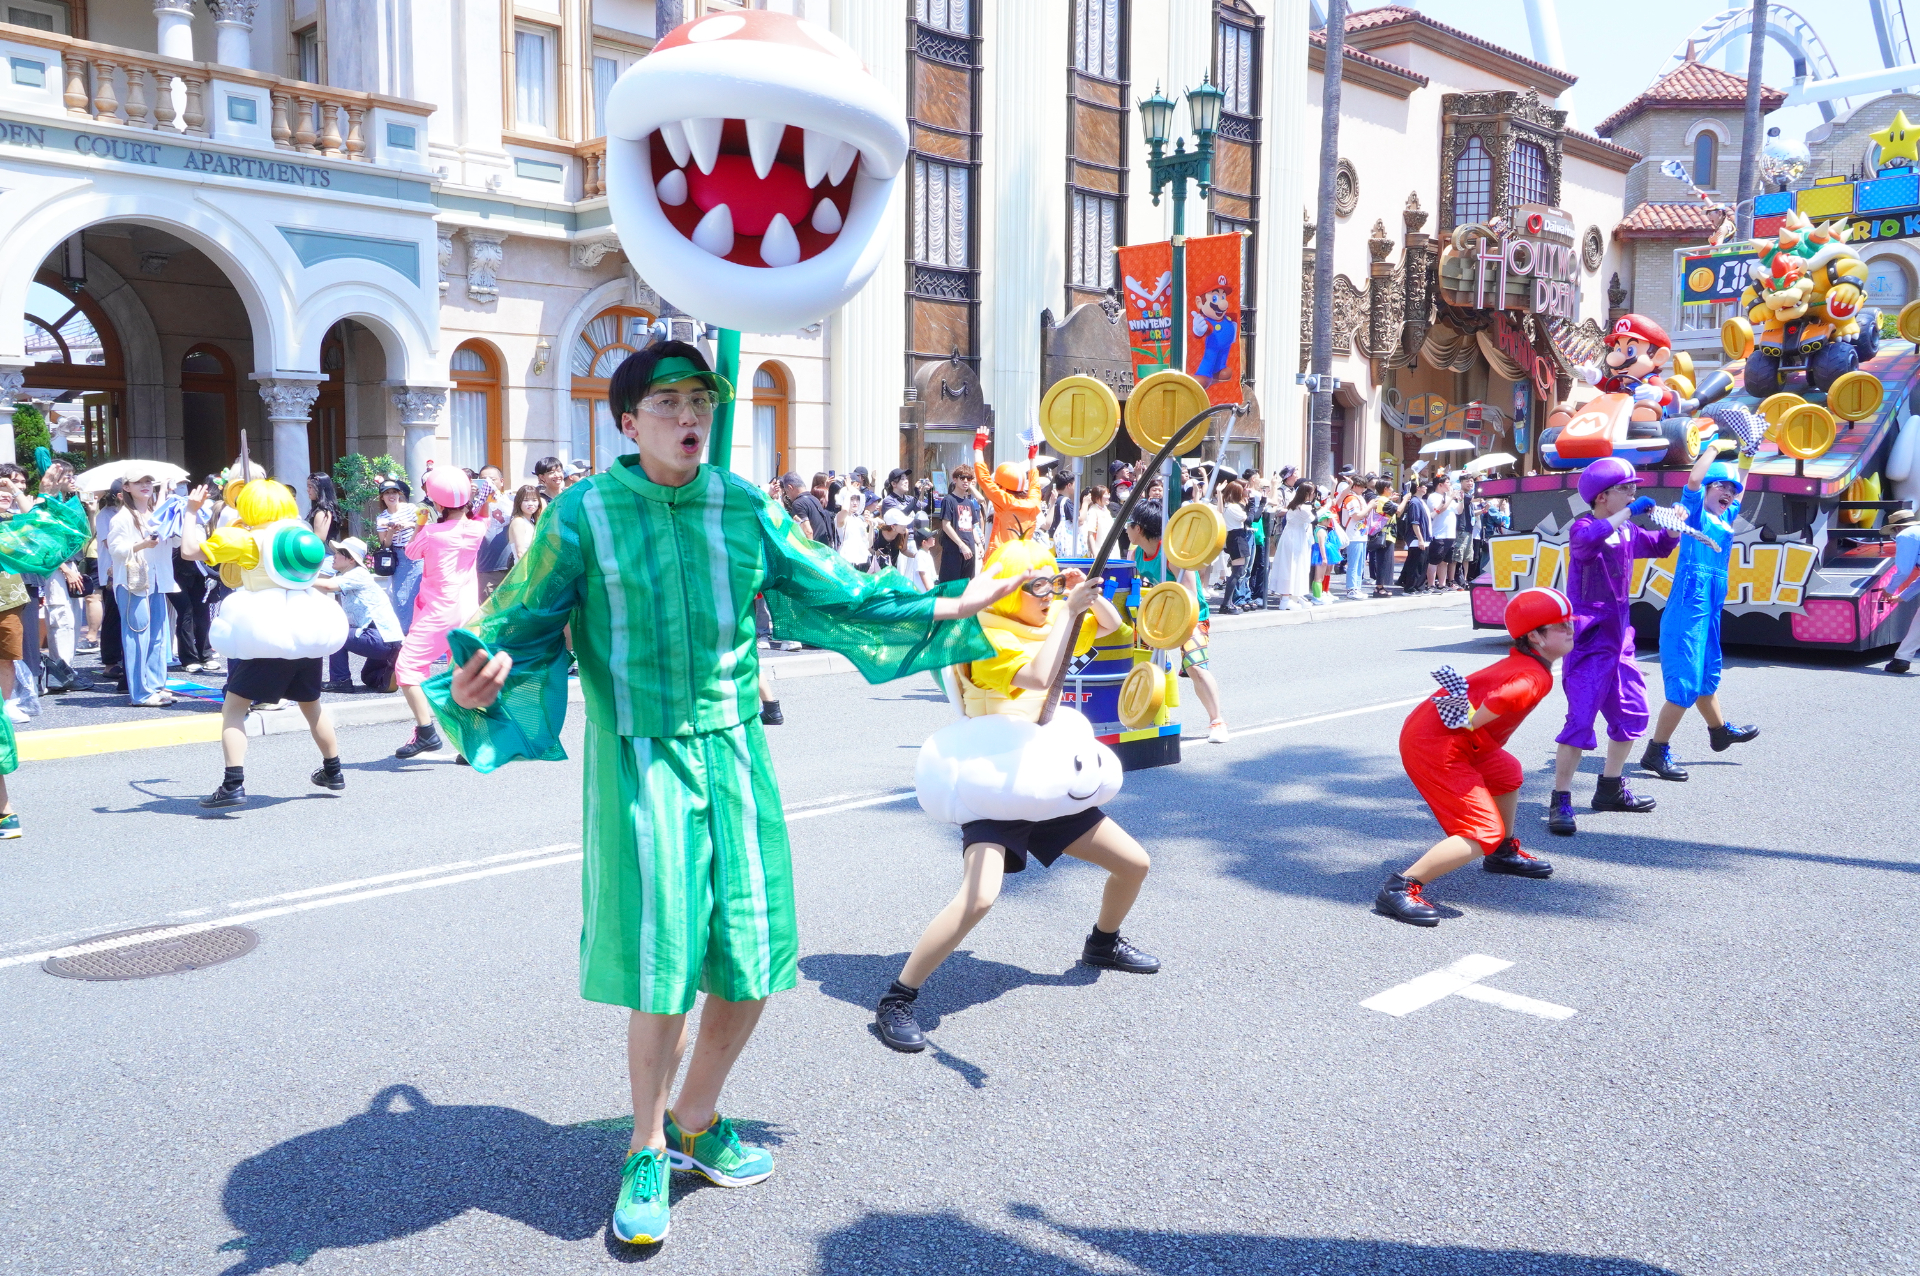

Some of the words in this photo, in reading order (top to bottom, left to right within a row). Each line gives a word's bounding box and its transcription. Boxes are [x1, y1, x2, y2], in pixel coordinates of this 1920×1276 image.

[74, 134, 162, 164] COURT
[183, 150, 331, 188] APARTMENTS
[1843, 218, 1901, 241] RIO
[1477, 237, 1582, 311] HOLLYWO
[1128, 316, 1171, 331] NINTEND
[1138, 328, 1171, 342] WORLD
[1105, 369, 1134, 384] FACT
